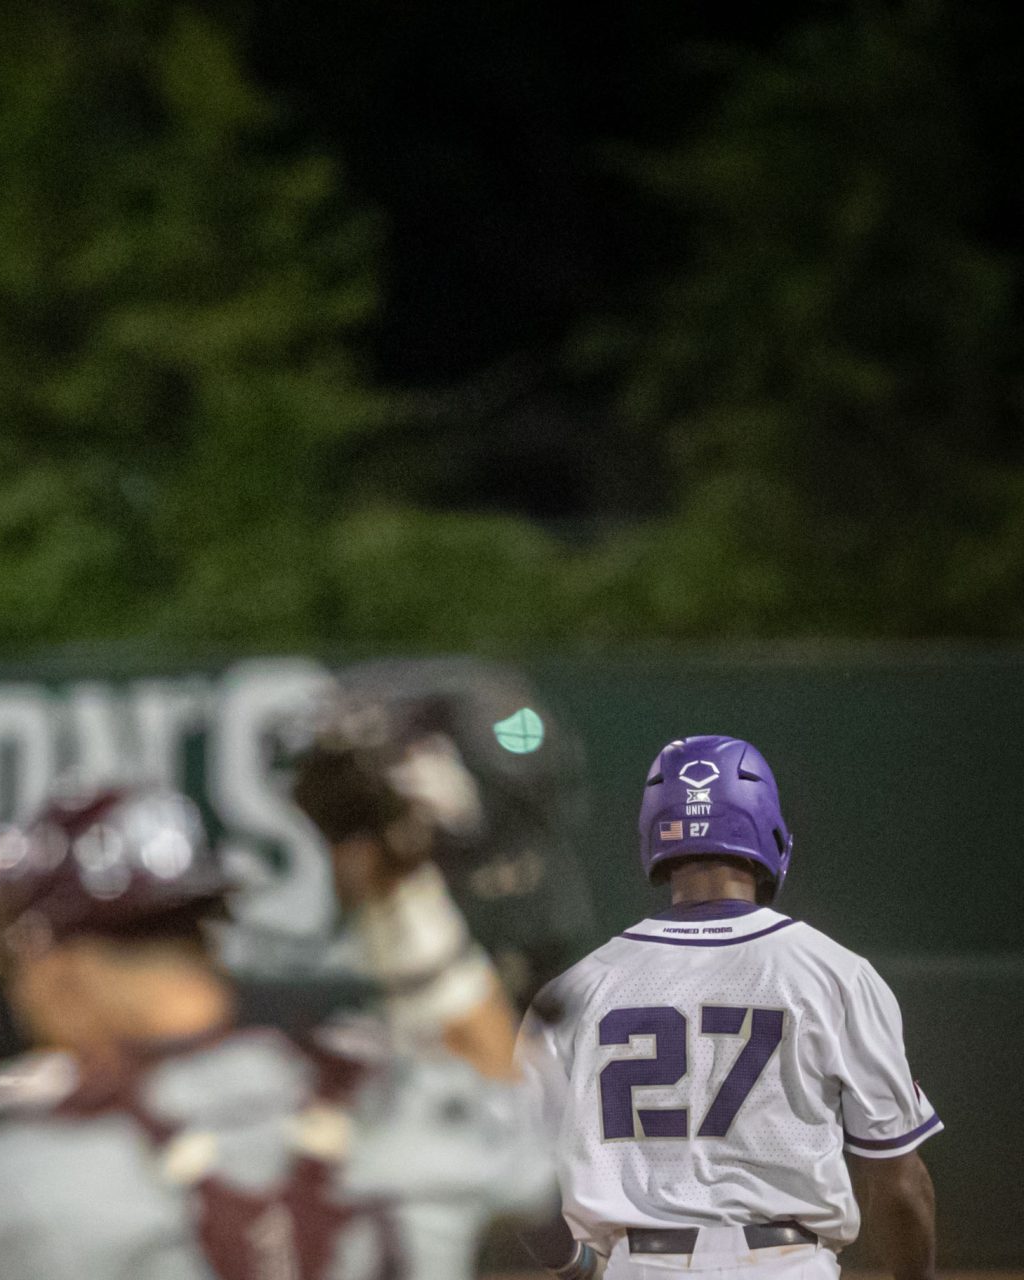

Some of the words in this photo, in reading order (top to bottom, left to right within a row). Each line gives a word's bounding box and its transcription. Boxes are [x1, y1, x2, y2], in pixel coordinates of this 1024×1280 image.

[686, 804, 712, 816] UNITY
[689, 822, 710, 837] 27
[597, 1004, 788, 1144] 27
